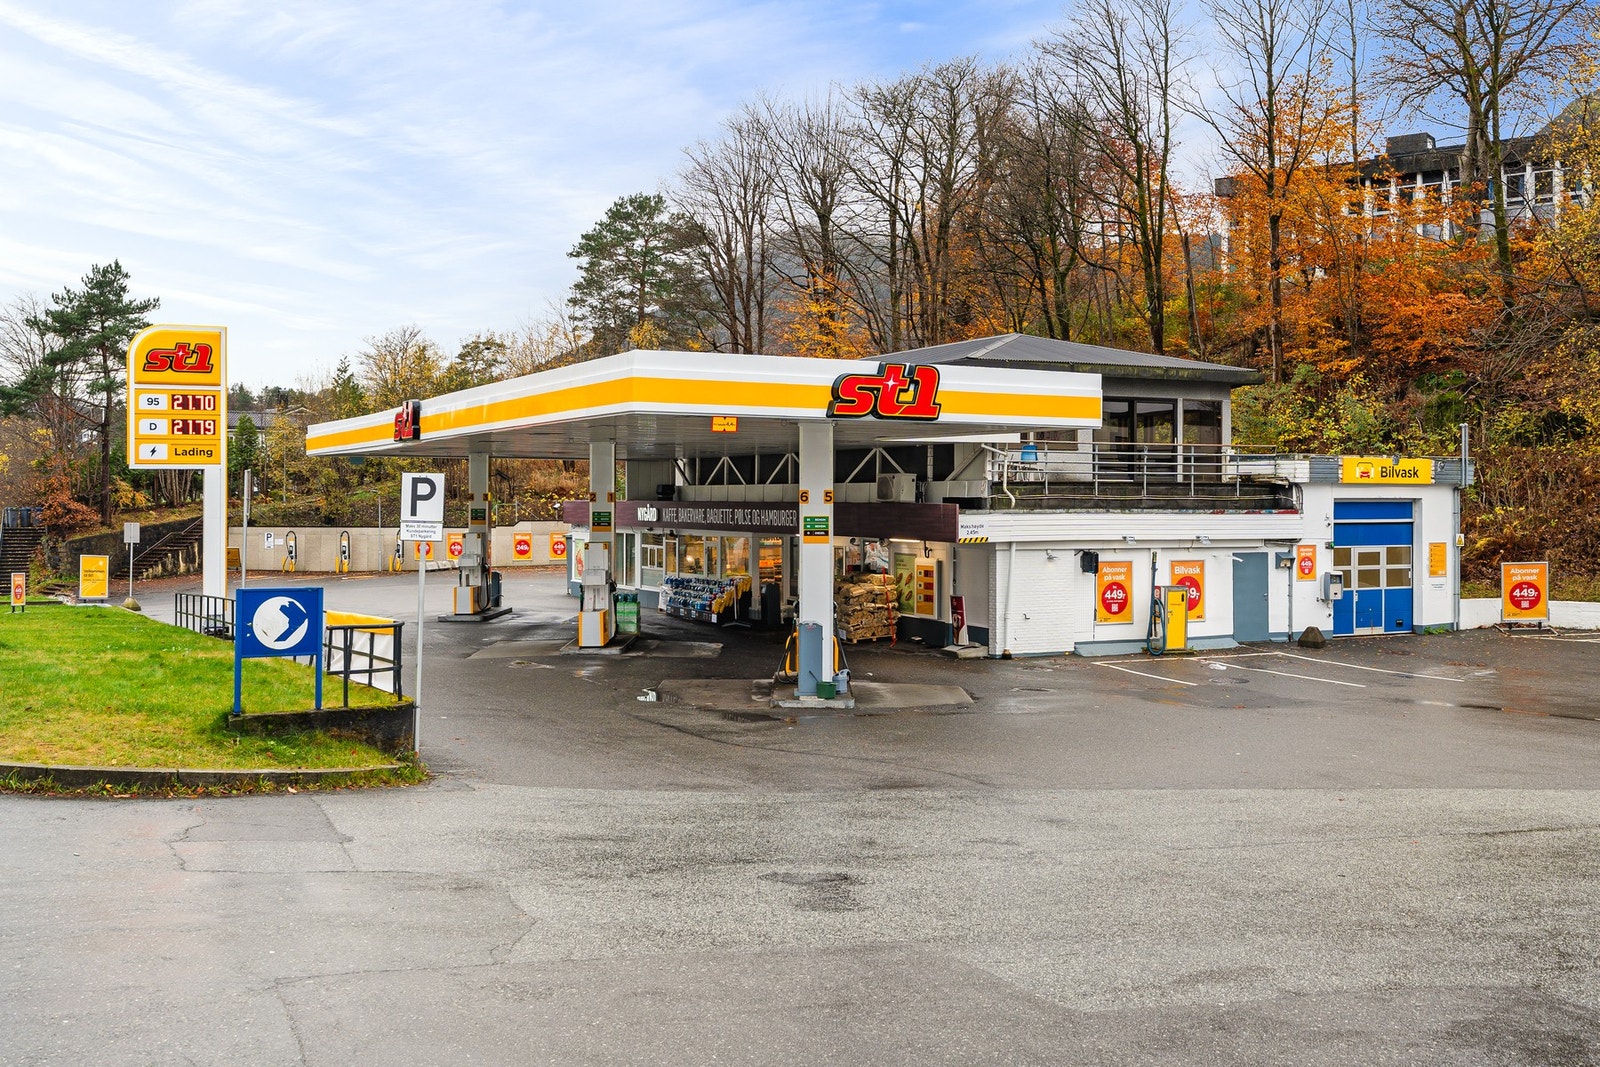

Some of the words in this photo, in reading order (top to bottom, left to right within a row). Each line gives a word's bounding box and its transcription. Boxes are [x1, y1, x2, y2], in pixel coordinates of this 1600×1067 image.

[143, 343, 213, 373] st1
[827, 363, 942, 421] st1
[147, 398, 160, 406] 95
[173, 395, 214, 411] 21.70
[149, 423, 158, 431] D
[173, 420, 214, 435] 21.79
[174, 447, 213, 457] Lading
[1380, 466, 1419, 479] Bilvask
[410, 477, 437, 517] P
[590, 493, 597, 503] 2
[800, 492, 809, 502] 6
[824, 491, 833, 502] 5
[637, 503, 658, 522] NYGÅRD
[662, 507, 678, 524] KAFFE,
[678, 507, 707, 525] BAKERVARE,
[706, 508, 734, 526] BAGUETTE,
[734, 509, 751, 525] PØLSE
[751, 509, 760, 526] OG
[760, 509, 798, 527] HAMBURGER
[266, 533, 273, 541] P
[1174, 565, 1201, 574] Bilvask
